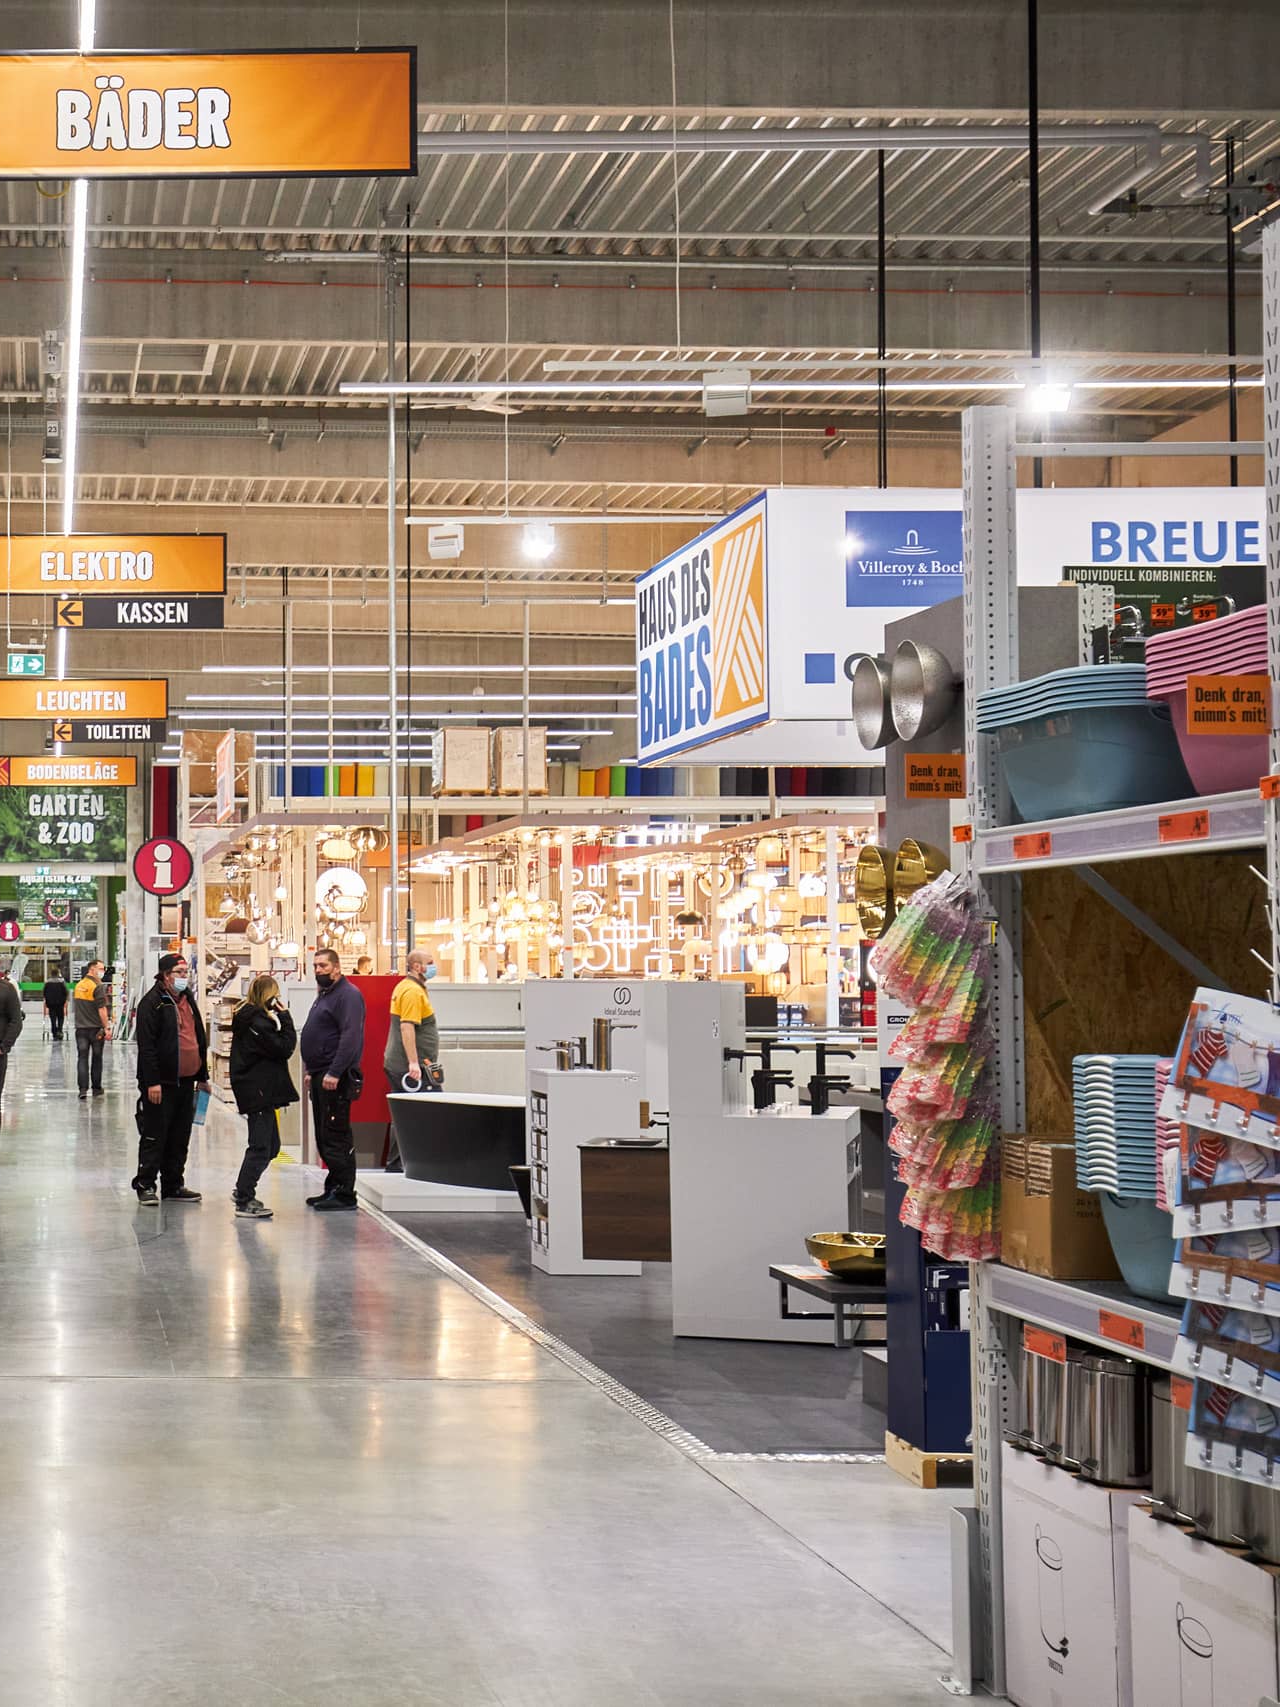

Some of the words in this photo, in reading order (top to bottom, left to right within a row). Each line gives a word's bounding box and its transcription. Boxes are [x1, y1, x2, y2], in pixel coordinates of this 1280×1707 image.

[56, 75, 231, 151] BÄDER
[1091, 521, 1261, 563] BREUE
[41, 551, 154, 581] ELEKTRO
[858, 561, 915, 576] Villeroy
[919, 563, 928, 573] &
[1069, 569, 1135, 582] INDIVIDUELL
[1138, 570, 1216, 583] KOMBINIEREN:
[639, 569, 676, 651] HAUS
[681, 548, 711, 627] DES
[117, 602, 188, 624] KASSEN
[640, 624, 712, 749] BADES
[1196, 687, 1226, 702] Denk
[1233, 687, 1264, 704] dran,
[36, 691, 126, 711] LEUCHTEN
[1242, 707, 1266, 723] mit!
[86, 724, 151, 740] TOILETTEN
[27, 762, 118, 780] BODENBELÄGE
[910, 765, 932, 777] Denk
[937, 765, 961, 778] dran,
[944, 781, 962, 792] mit!
[29, 794, 104, 817] GARTEN
[38, 822, 53, 843] &
[56, 822, 95, 844] ZOO
